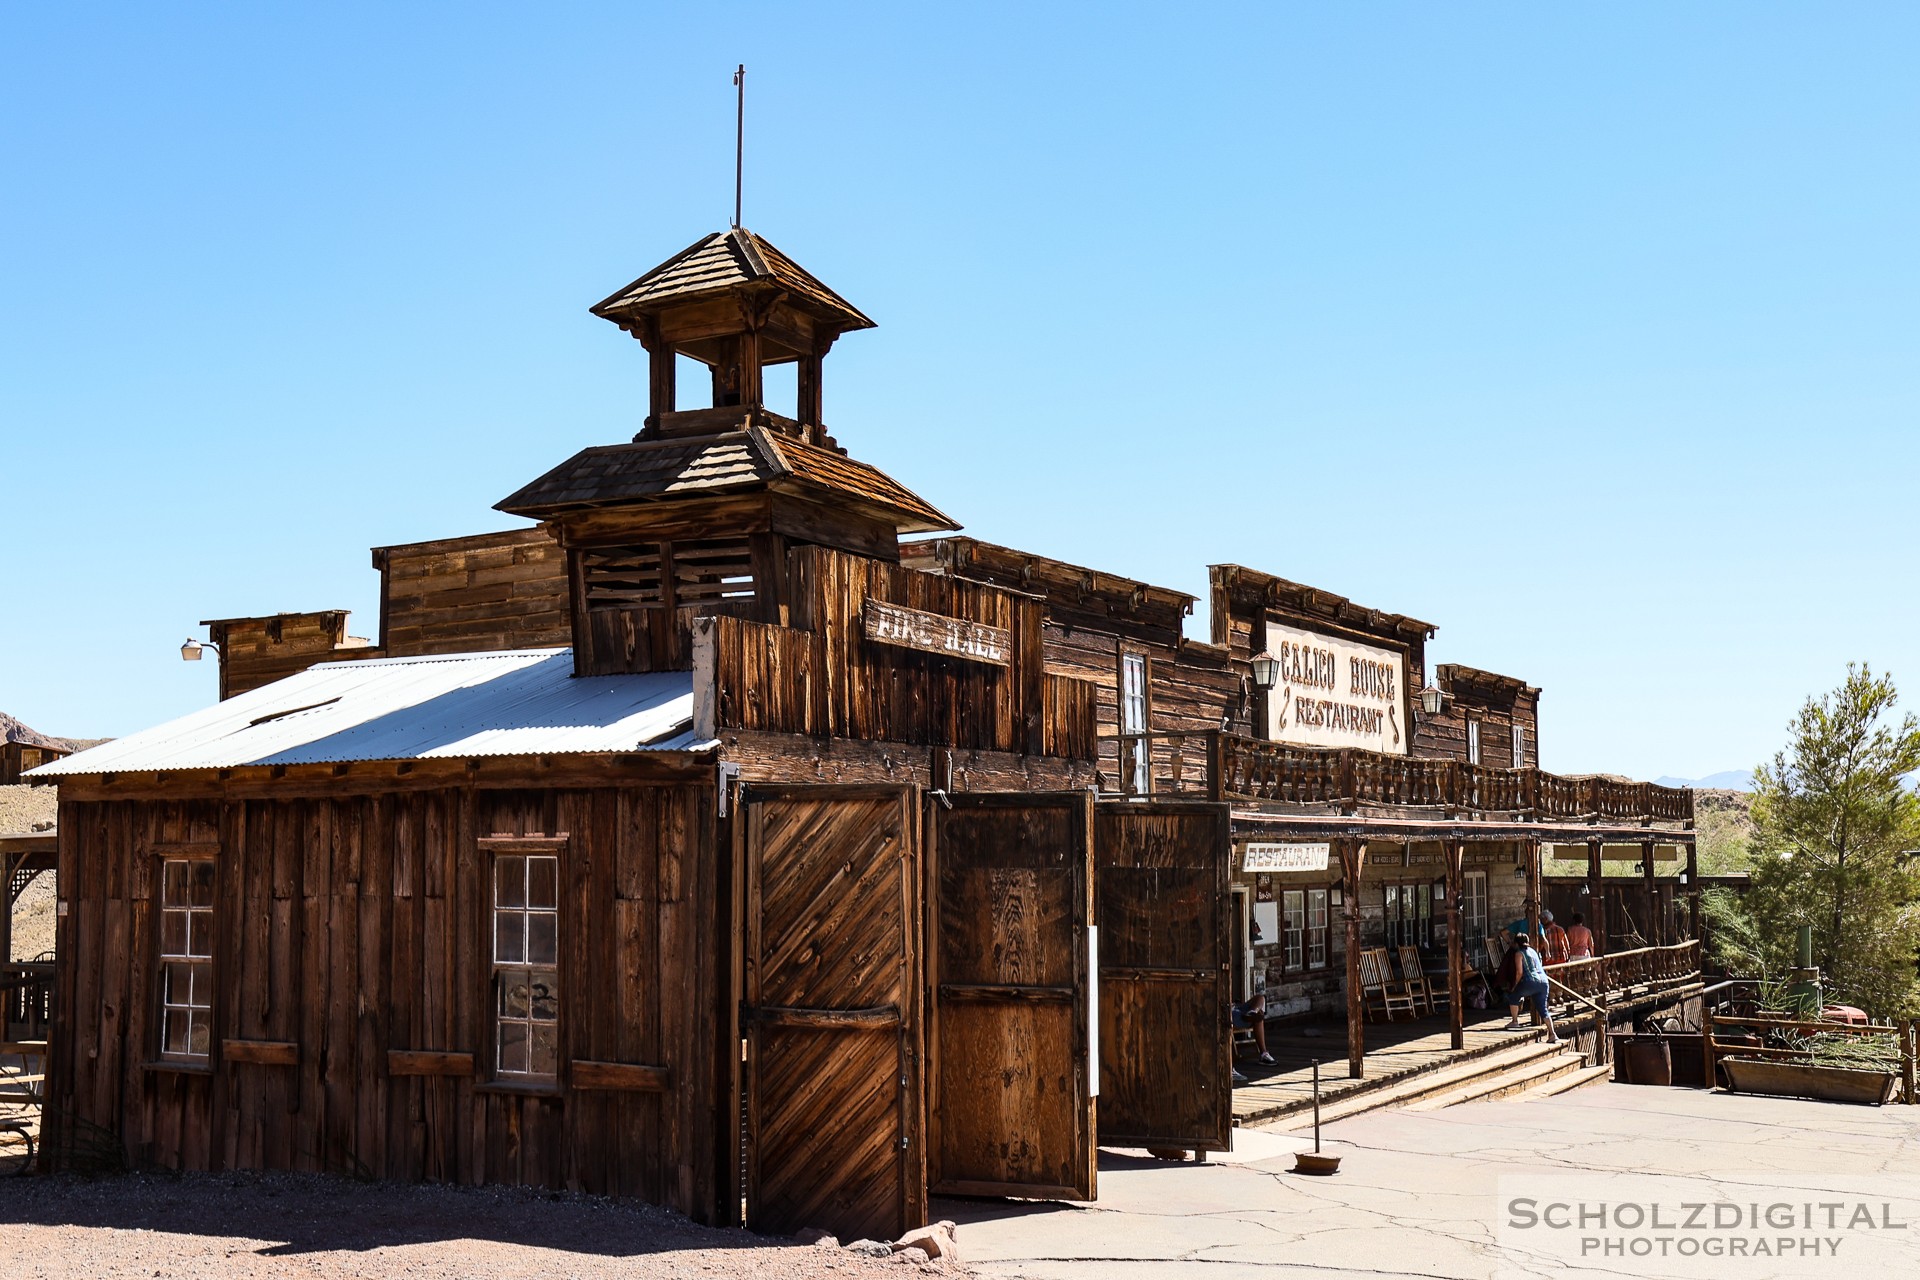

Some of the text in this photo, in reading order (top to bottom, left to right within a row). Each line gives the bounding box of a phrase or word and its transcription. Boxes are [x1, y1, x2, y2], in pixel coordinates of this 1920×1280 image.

[877, 606, 1001, 660] FIRE HALL
[1280, 640, 1395, 701] CALICO HOUSE
[1295, 696, 1384, 734] RESTAURANT
[1246, 848, 1327, 867] RESTAURANT
